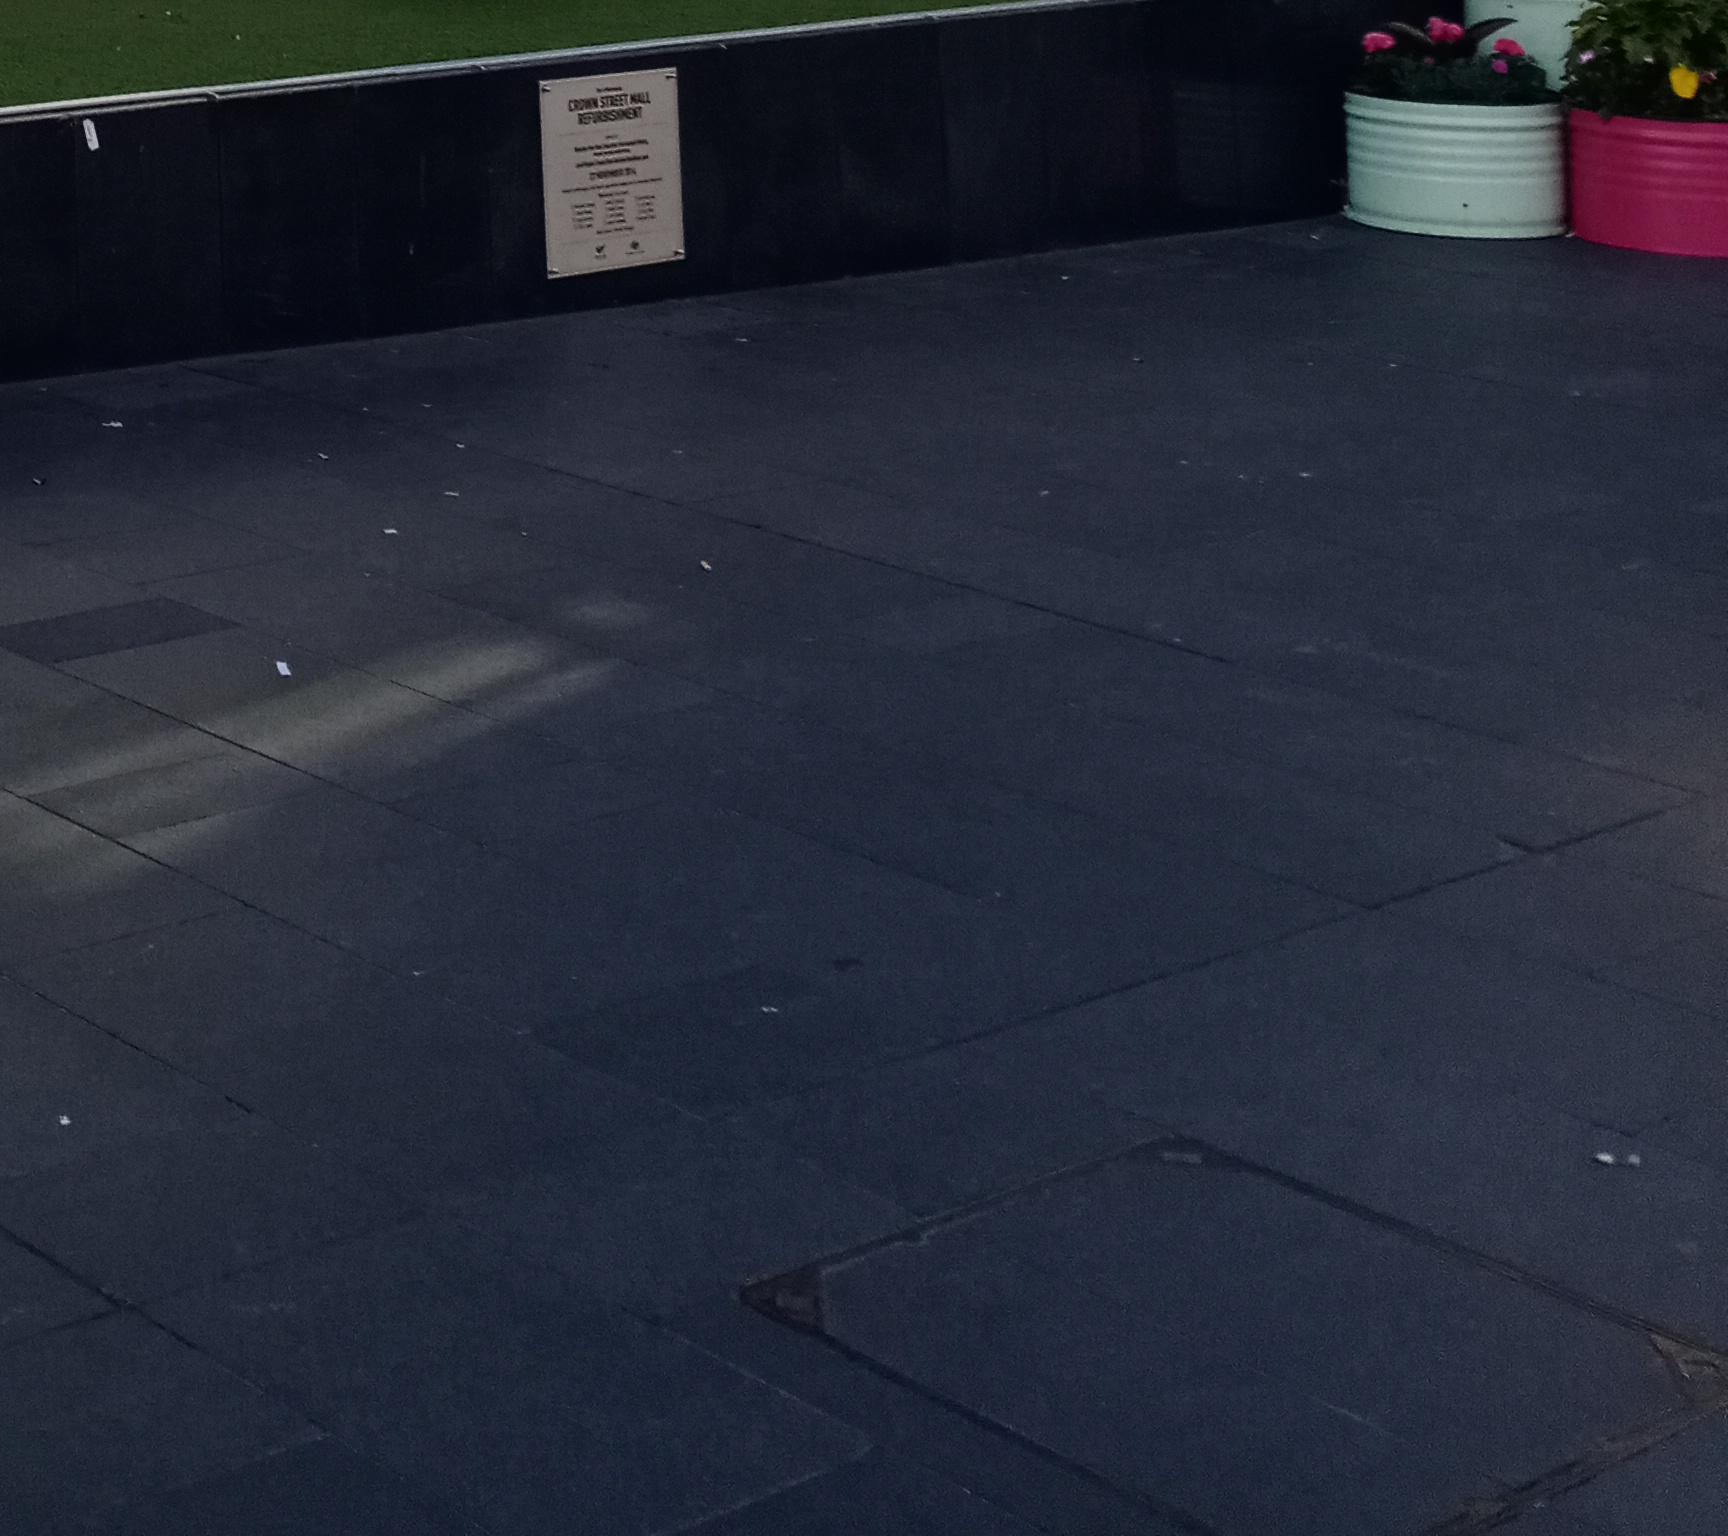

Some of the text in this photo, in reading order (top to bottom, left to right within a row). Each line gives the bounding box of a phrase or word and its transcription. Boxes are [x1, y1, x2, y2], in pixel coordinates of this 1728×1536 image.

[569, 91, 651, 111] CROWN STREET MALL
[578, 106, 642, 125] REFURBISHMENT
